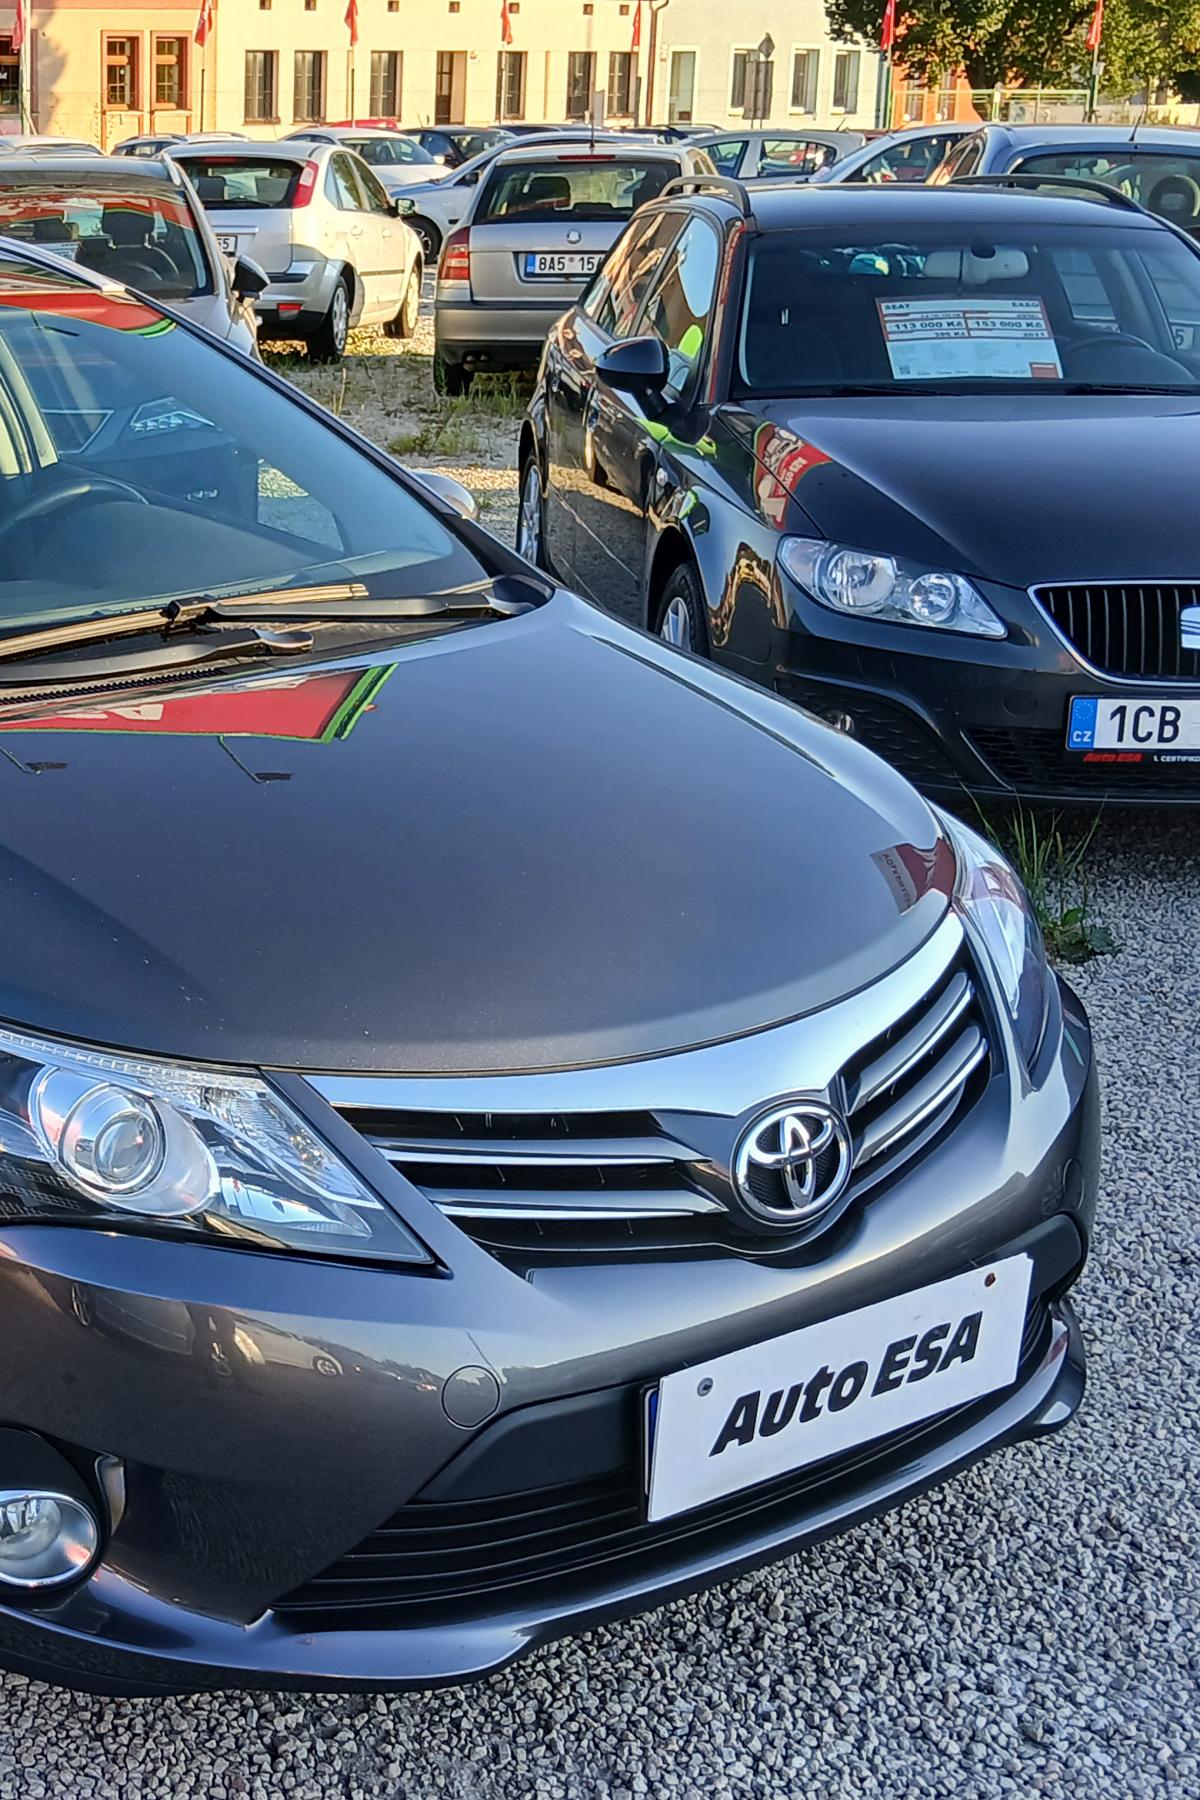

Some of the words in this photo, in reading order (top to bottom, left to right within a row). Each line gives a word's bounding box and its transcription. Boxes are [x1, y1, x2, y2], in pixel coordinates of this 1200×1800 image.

[538, 256, 566, 271] 8A5
[578, 256, 603, 271] 15
[1072, 730, 1093, 743] CZ
[1109, 704, 1181, 744] 1CB
[708, 1360, 869, 1458] Auto
[871, 1310, 983, 1398] ESA
